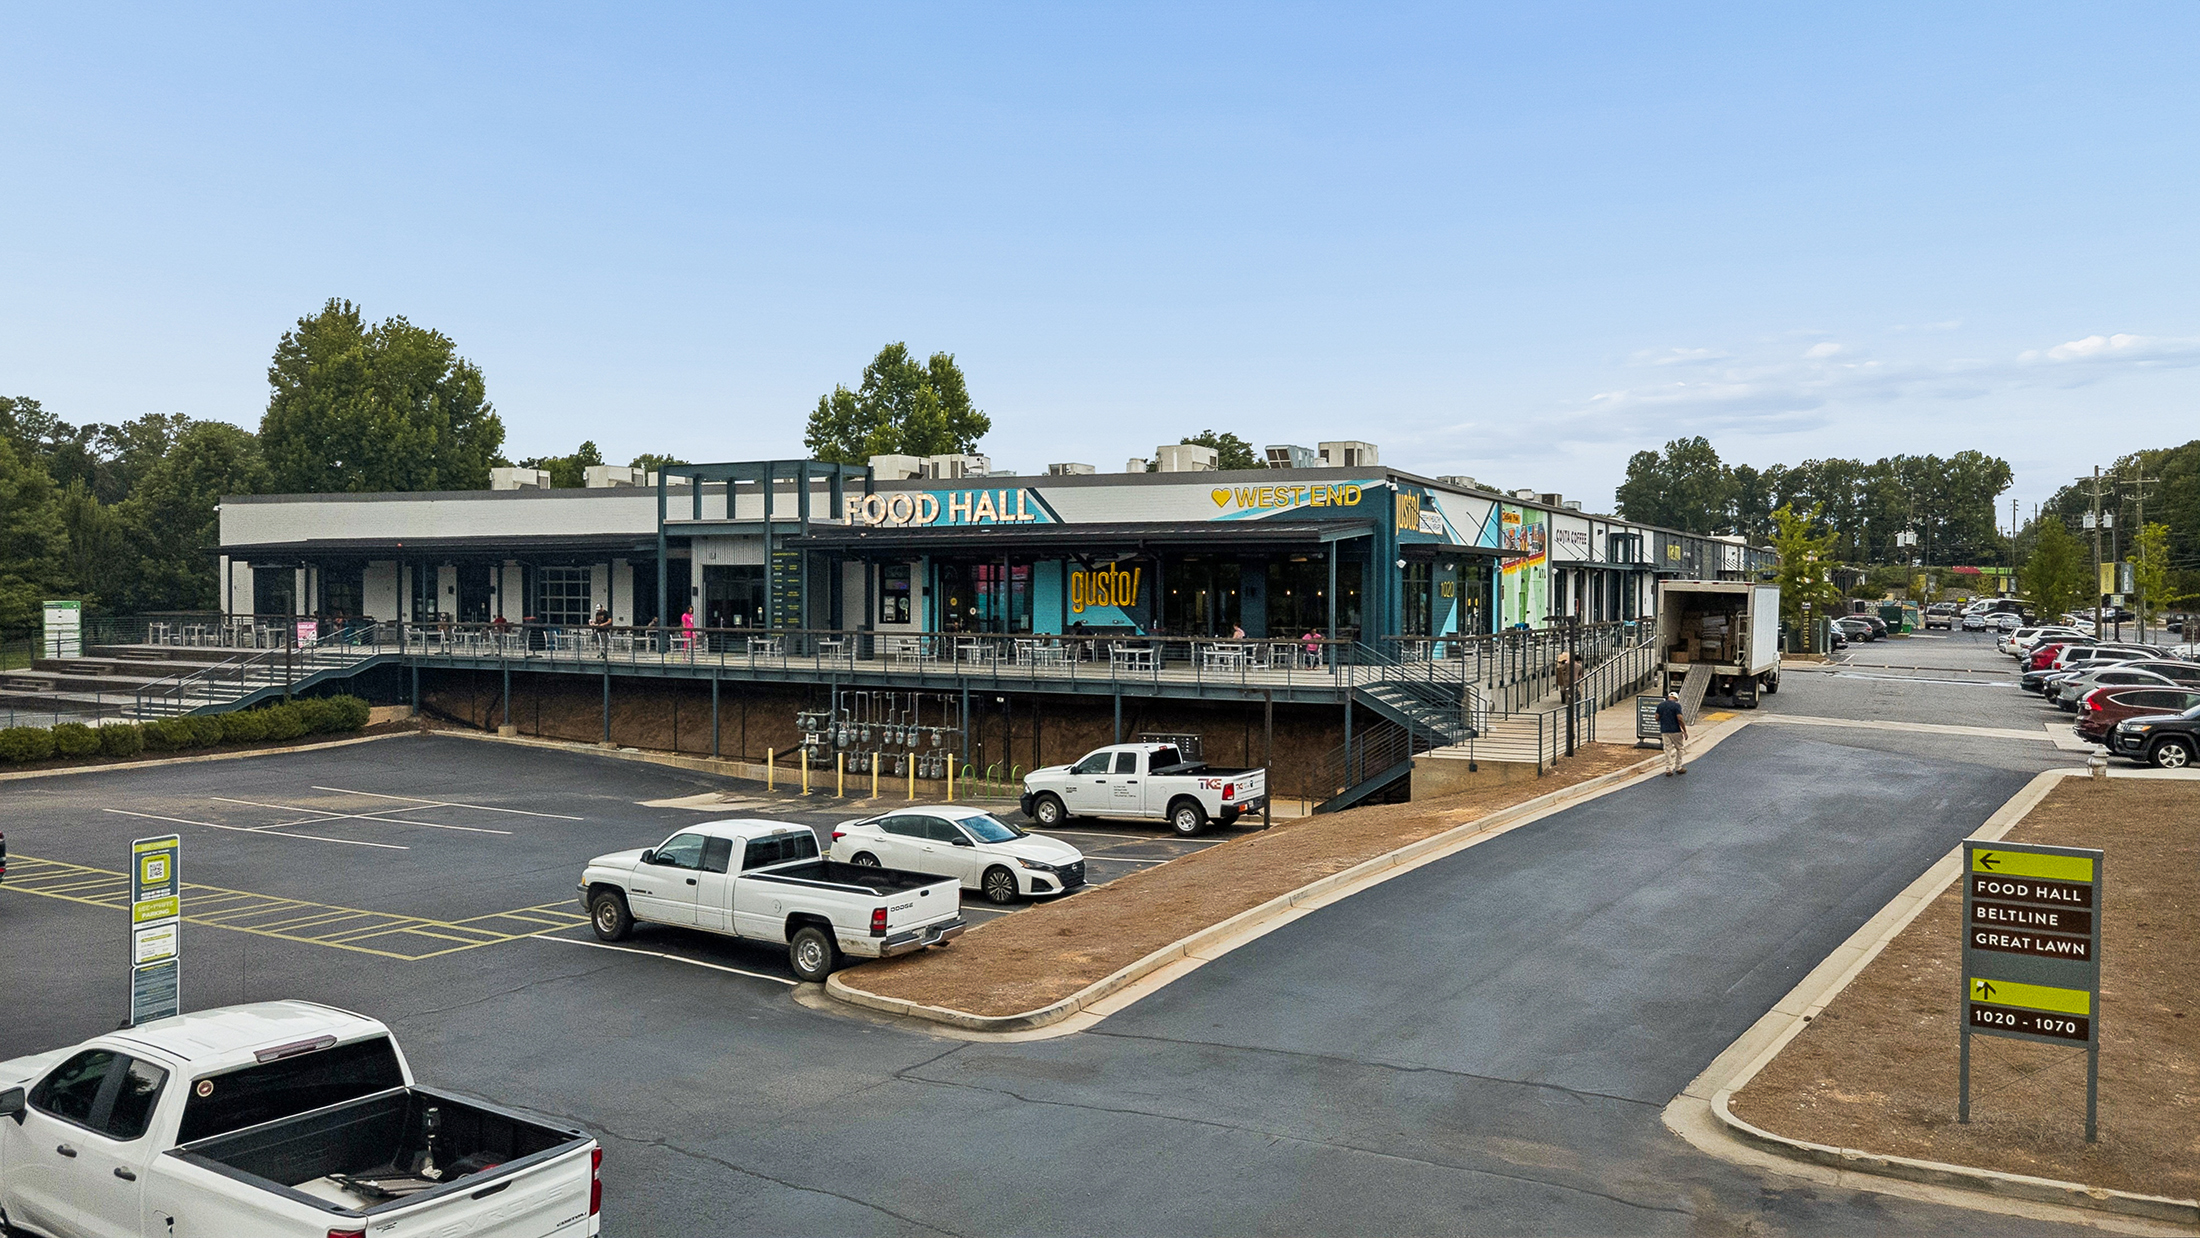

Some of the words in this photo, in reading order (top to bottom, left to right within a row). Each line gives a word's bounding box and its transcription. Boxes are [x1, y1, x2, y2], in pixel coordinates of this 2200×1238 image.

[1234, 485, 1305, 508] WEST
[1309, 483, 1362, 507] END
[844, 492, 940, 526] FOOD
[948, 488, 1036, 522] HALL
[1555, 528, 1570, 544] COSTA
[1570, 530, 1587, 545] COFFEE
[1071, 561, 1141, 613] gusto!
[1440, 581, 1455, 598] 1020
[1197, 778, 1222, 790] TKE
[1976, 880, 2029, 896] FOOD
[2036, 886, 2082, 902] HALL
[890, 902, 914, 913] DODGE
[1976, 907, 2059, 926] BELTLINE
[1975, 933, 2031, 948] GREAT
[2036, 938, 2086, 955] LAWN
[1975, 1010, 2016, 1026] 1020
[2035, 1017, 2076, 1034] 1070
